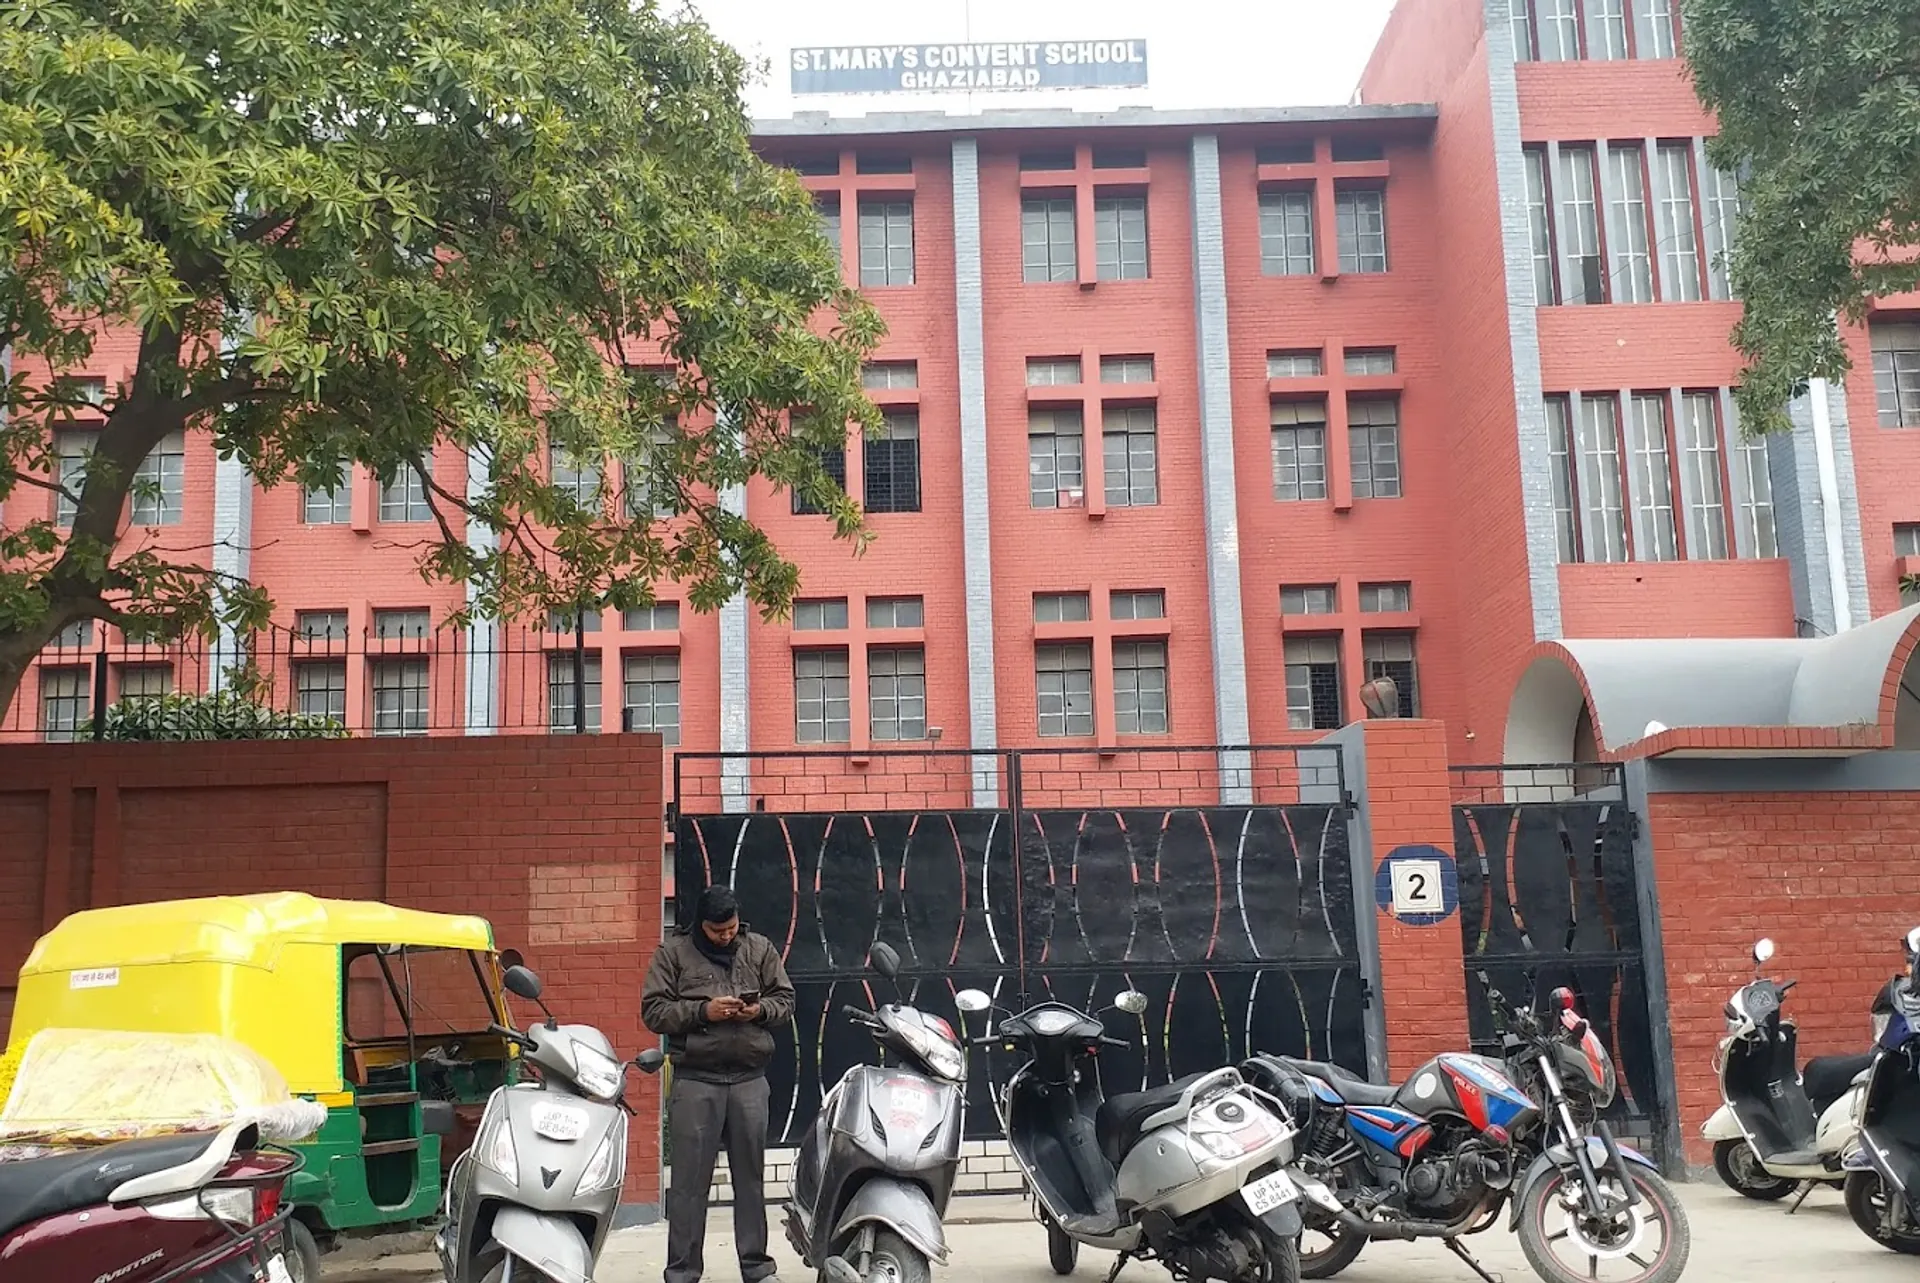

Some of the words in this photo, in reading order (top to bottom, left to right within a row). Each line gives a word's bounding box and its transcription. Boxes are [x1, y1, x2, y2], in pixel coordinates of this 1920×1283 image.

[793, 45, 918, 71] ST.MARY'S
[924, 43, 1040, 68] CONVENT
[1044, 41, 1143, 65] SCHOOL
[900, 68, 1040, 89] GHAZIABAD
[1408, 873, 1426, 900] 2
[1253, 1187, 1266, 1199] UP
[1268, 1181, 1281, 1191] 14
[1255, 1199, 1269, 1210] CS
[94, 1247, 165, 1283] AVIATOR
